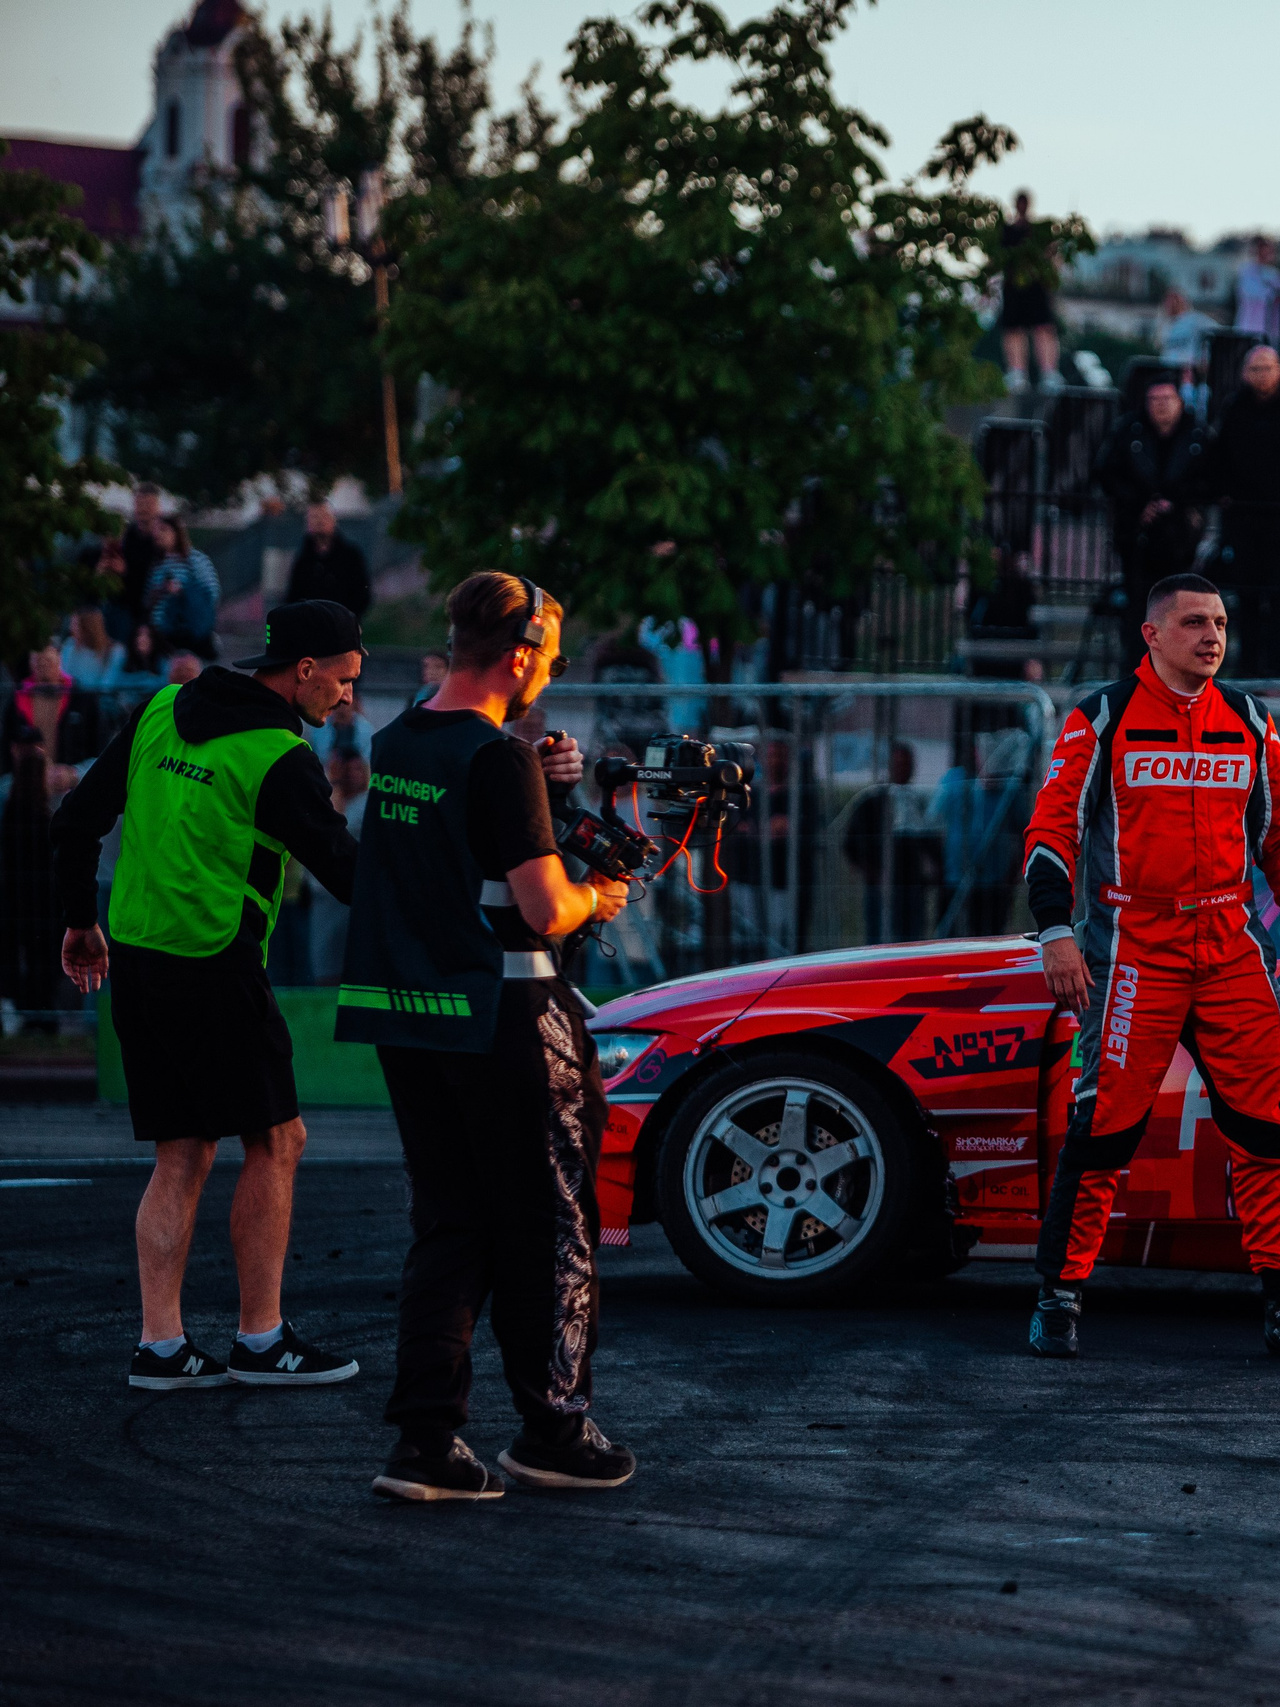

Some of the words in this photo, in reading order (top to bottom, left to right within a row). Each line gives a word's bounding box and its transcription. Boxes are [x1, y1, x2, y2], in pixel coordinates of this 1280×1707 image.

[637, 770, 672, 780] RONIN
[1132, 757, 1245, 782] FONBET
[380, 801, 419, 825] LIVE
[1106, 963, 1139, 1070] FONBET
[955, 1136, 1017, 1146] SHOPMARKA
[955, 1144, 995, 1153] motorsport
